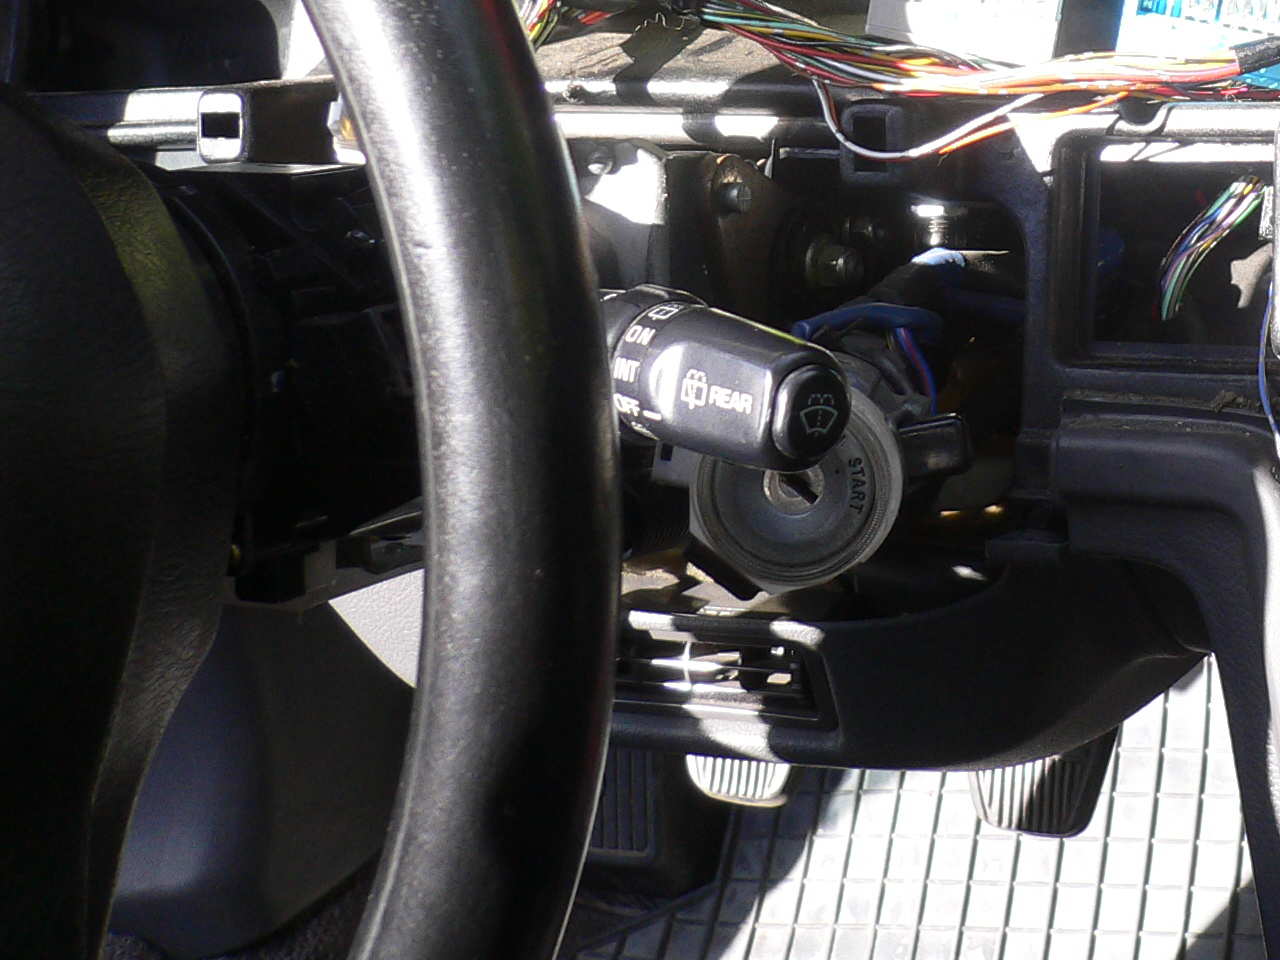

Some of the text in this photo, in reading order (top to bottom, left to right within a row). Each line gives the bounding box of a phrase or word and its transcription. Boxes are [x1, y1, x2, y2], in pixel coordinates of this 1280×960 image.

[625, 325, 656, 346] ON
[613, 357, 640, 383] INT
[613, 393, 640, 417] OFF
[709, 385, 753, 415] REAR
[848, 457, 866, 515] START
